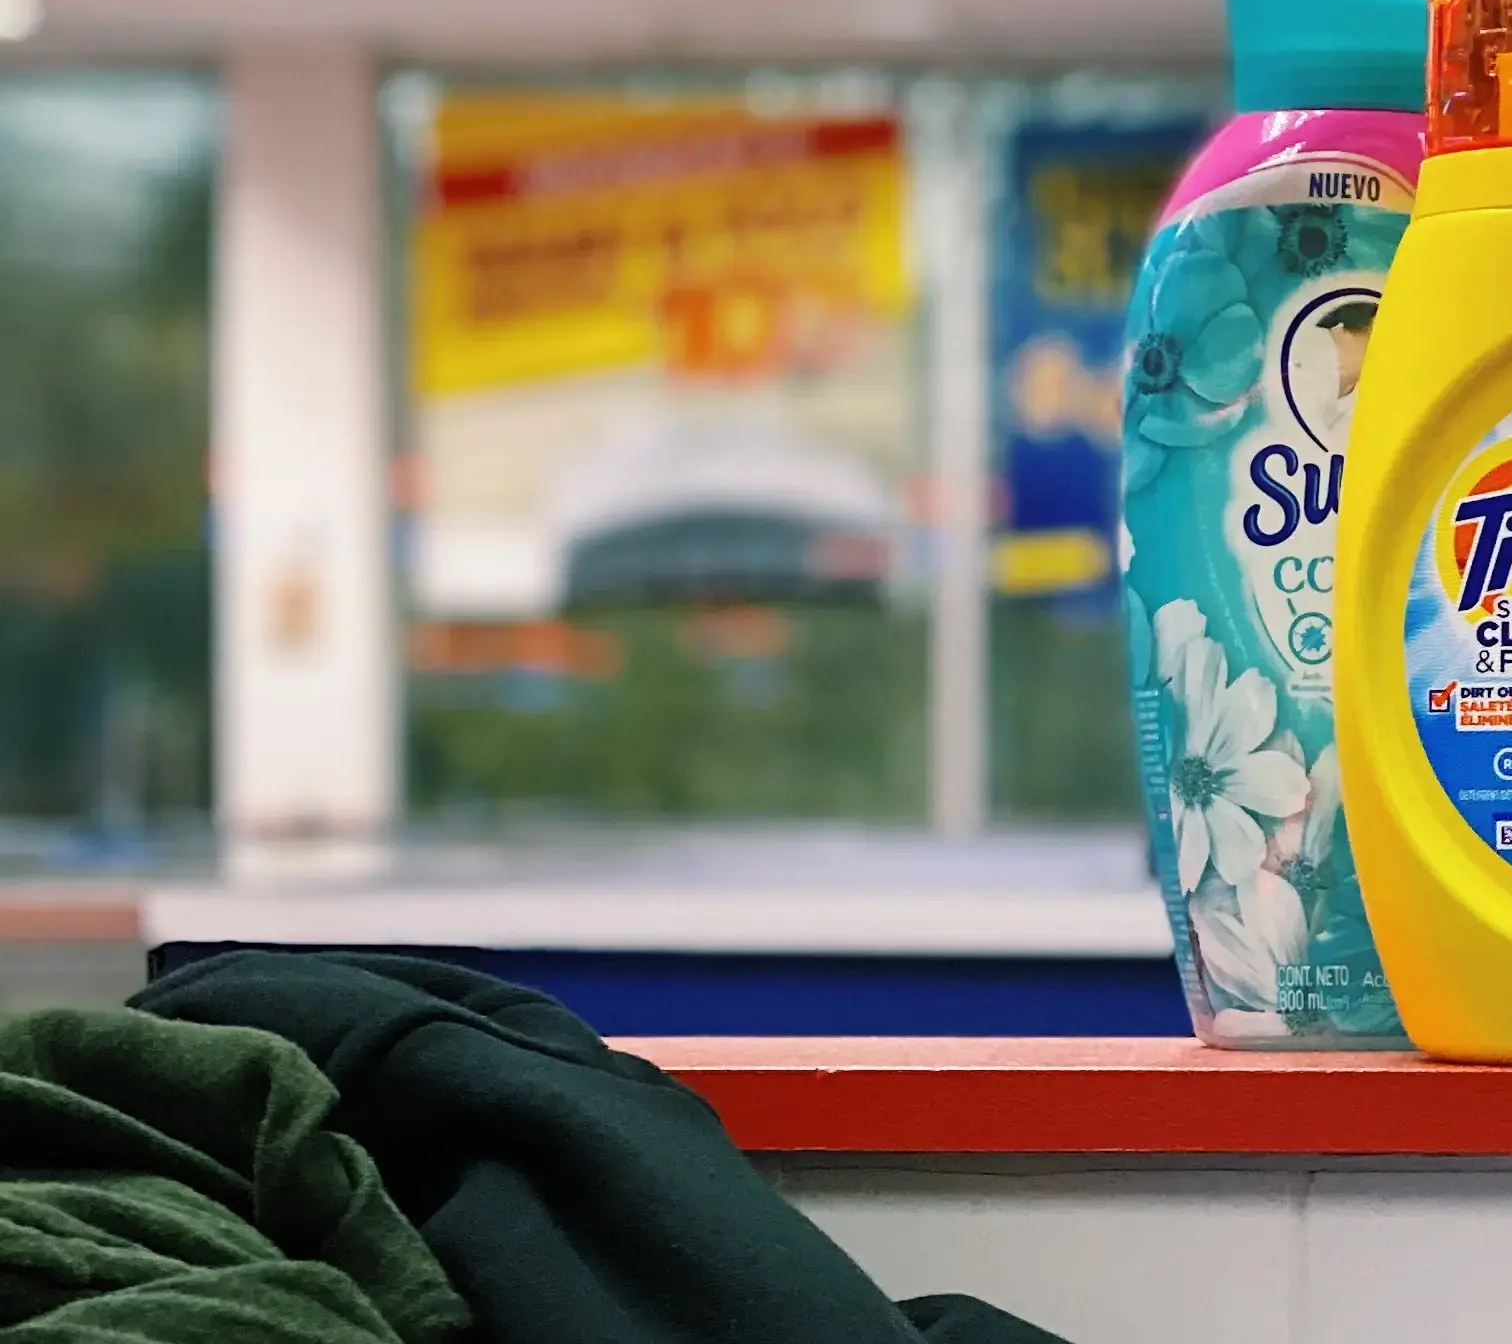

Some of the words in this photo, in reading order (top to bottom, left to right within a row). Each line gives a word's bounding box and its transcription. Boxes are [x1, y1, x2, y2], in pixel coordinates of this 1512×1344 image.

[1309, 173, 1381, 202] NUEVO
[1461, 686, 1493, 699] DIRT
[1316, 965, 1350, 987] NETO
[1280, 989, 1304, 1012] 800
[1308, 990, 1326, 1011] mL
